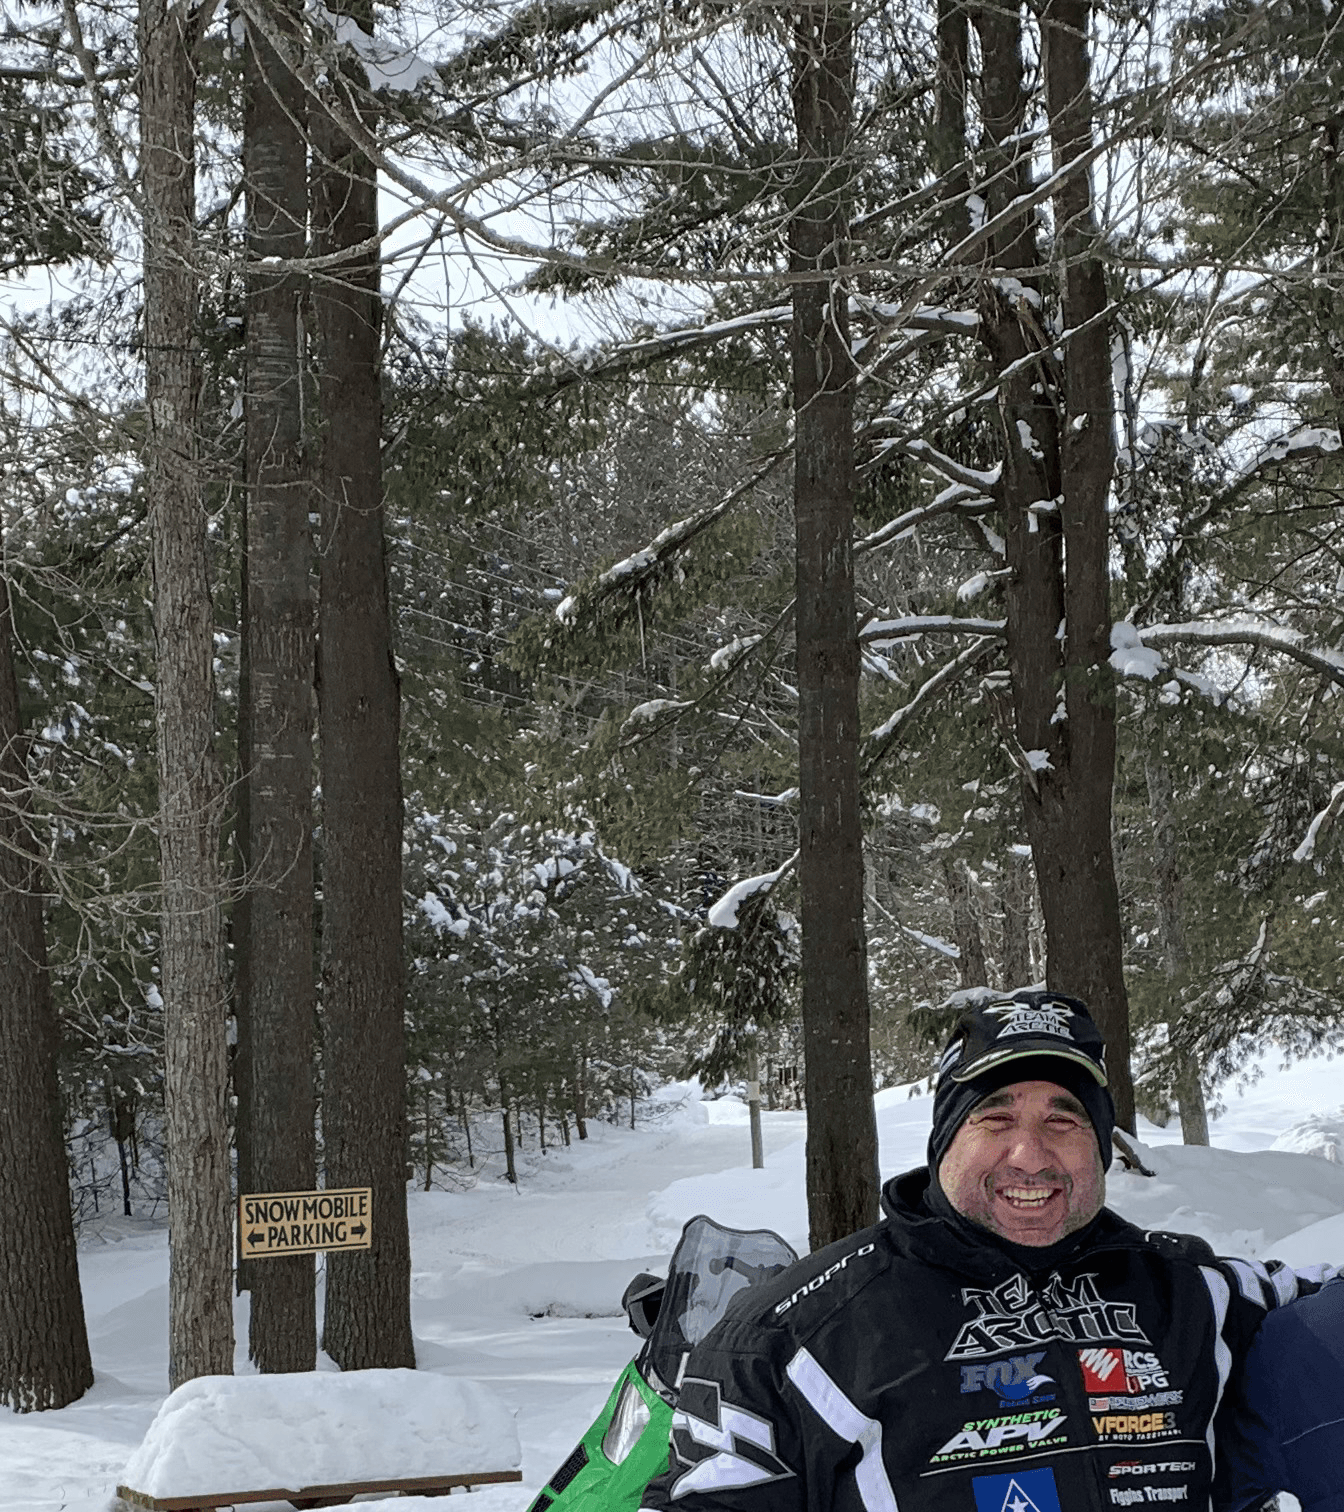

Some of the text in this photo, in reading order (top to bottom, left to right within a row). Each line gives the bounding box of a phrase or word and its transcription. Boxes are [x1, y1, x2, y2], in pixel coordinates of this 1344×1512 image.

[1002, 1022, 1070, 1036] ARCTIC
[1009, 1010, 1059, 1025] TEAM
[244, 1195, 369, 1225] SNOWMOBILE
[266, 1220, 348, 1249] PARKING
[943, 1300, 1154, 1362] ARCTIC
[1123, 1349, 1160, 1371] RCS
[959, 1350, 1049, 1397] FOX
[1126, 1371, 1170, 1395] UPG
[962, 1407, 1062, 1433] SYNTHETIC
[1091, 1411, 1177, 1435] VFORCE3
[935, 1415, 1069, 1456] APV
[1108, 1461, 1196, 1476] SPORTECH
